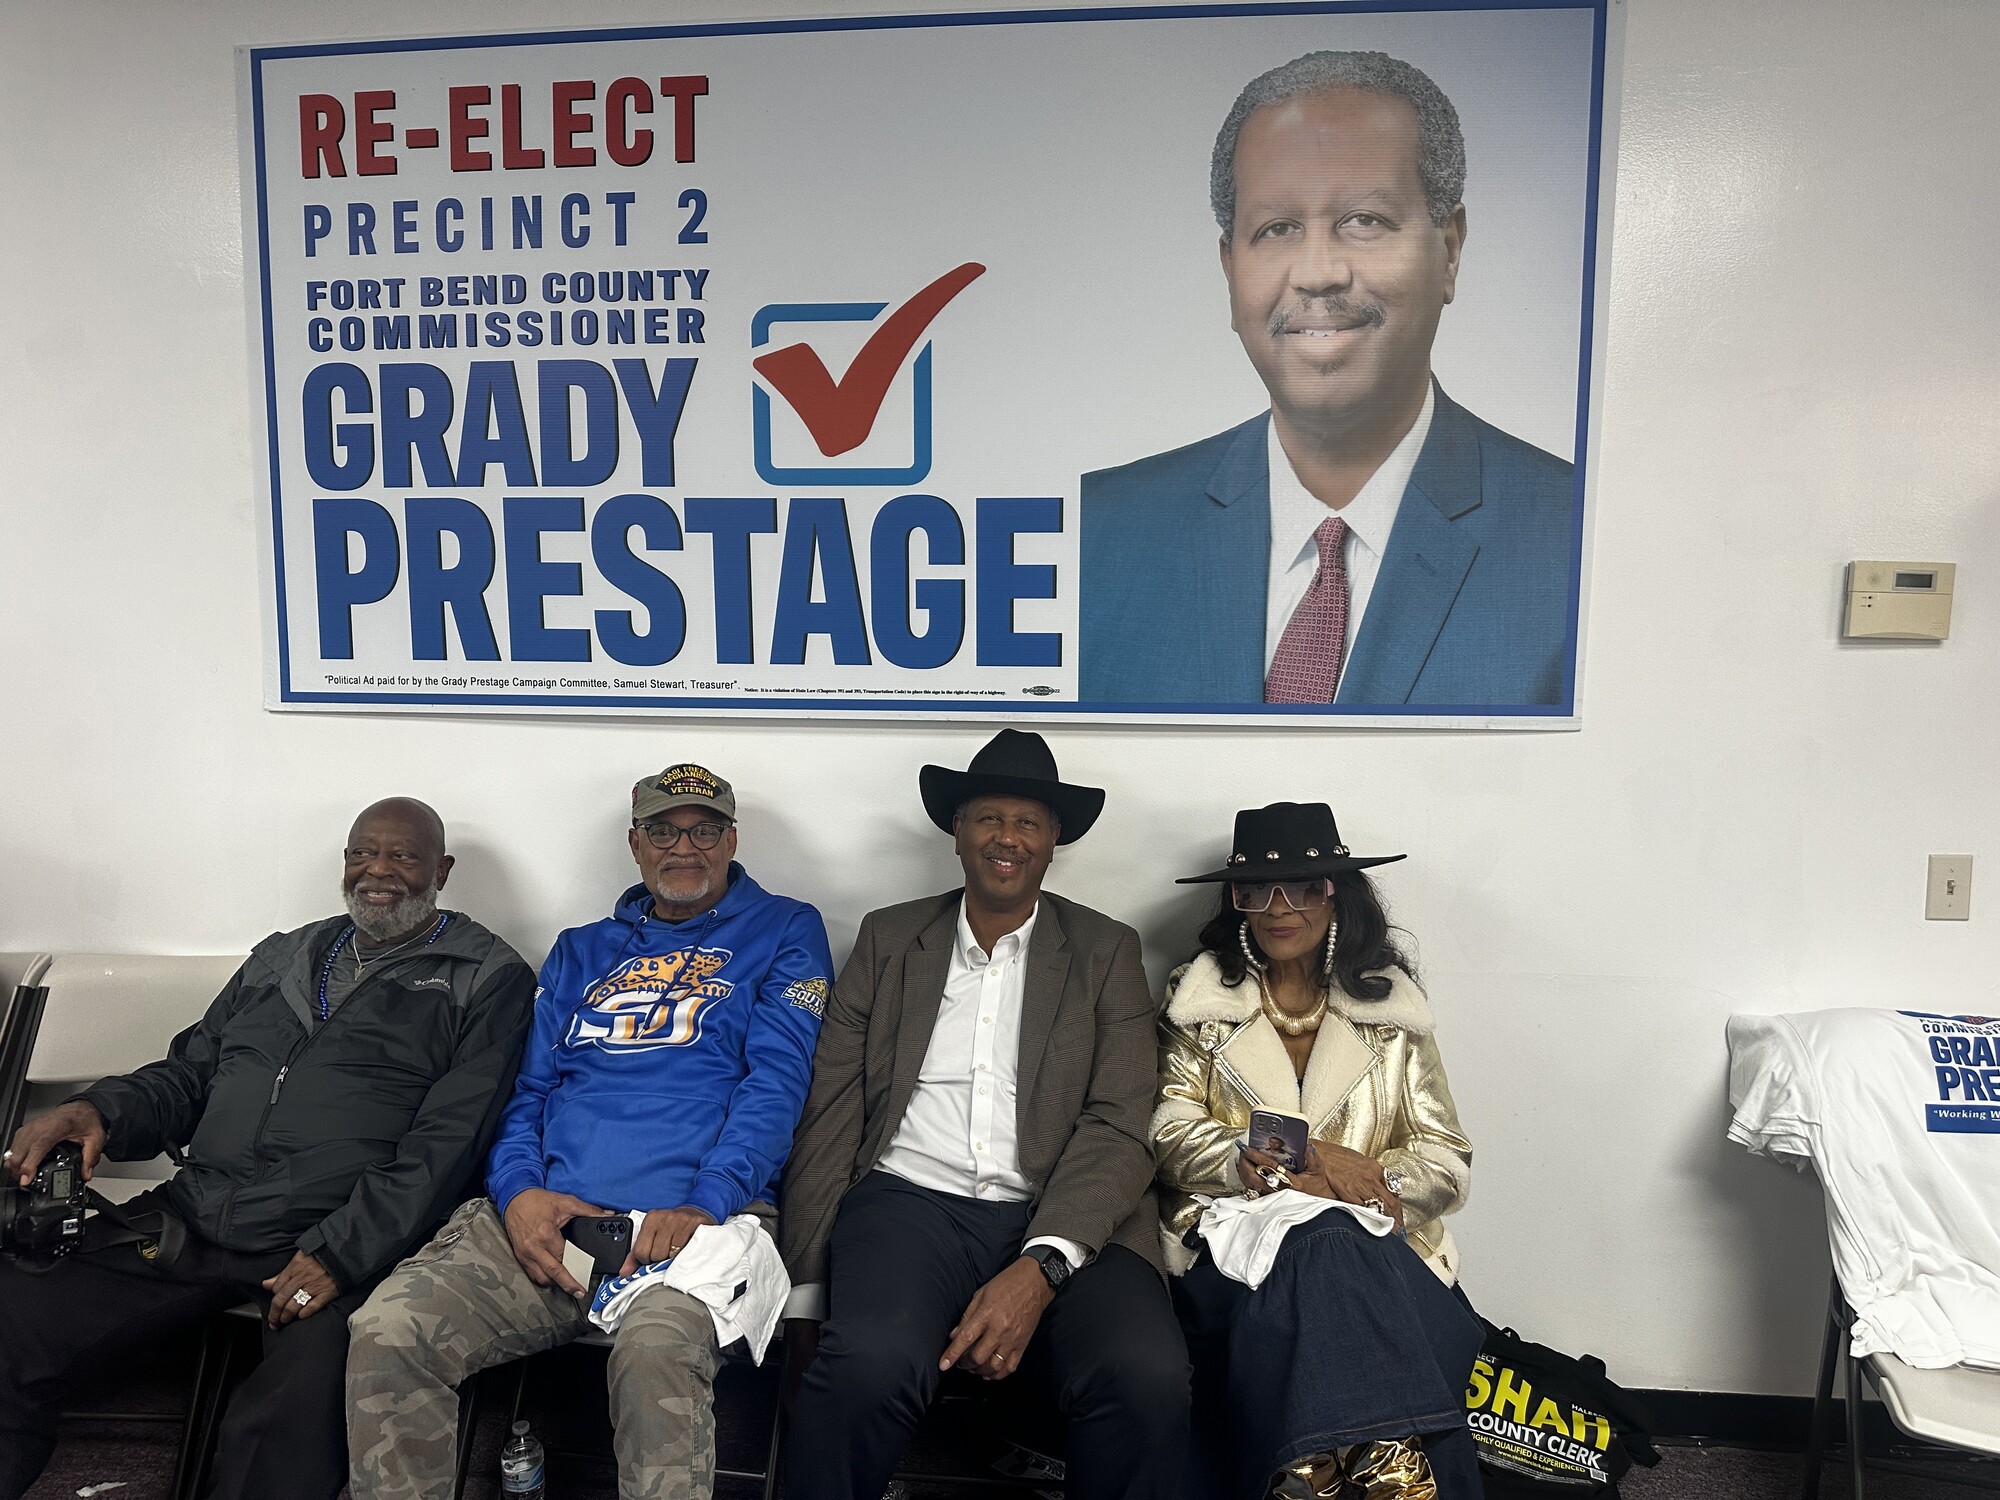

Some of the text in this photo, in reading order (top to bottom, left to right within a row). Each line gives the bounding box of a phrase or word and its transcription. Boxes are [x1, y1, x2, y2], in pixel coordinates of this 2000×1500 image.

[299, 75, 709, 179] RE-ELECT
[304, 188, 709, 258] PRECINCT 2
[306, 268, 710, 311] FORT BEND COUNTY
[308, 307, 706, 352] COMMISSIONER
[302, 357, 699, 493] GRADY
[312, 493, 1064, 670] PRESTAGE
[363, 675, 375, 685] Ad
[377, 675, 395, 687] paid
[398, 675, 410, 685] for
[412, 675, 423, 688] by
[425, 676, 439, 686] the
[441, 676, 468, 688] Grady
[470, 676, 510, 689] Prestage
[512, 676, 557, 689] Campaign
[559, 678, 611, 689] Committee,
[613, 678, 648, 689] Samuel
[650, 679, 688, 690] Stewart,
[671, 787, 714, 798] VETERAN
[1921, 1023, 2000, 1036] COMMISSI
[1477, 1351, 1497, 1364] LECT
[1465, 1359, 1611, 1451] SHAH
[1466, 1410, 1545, 1447] COUNTY
[1547, 1435, 1603, 1470] CLERK
[1494, 1440, 1533, 1458] QUALIFIED
[1532, 1453, 1538, 1461] &
[1538, 1454, 1586, 1473] EXPERIENCED
